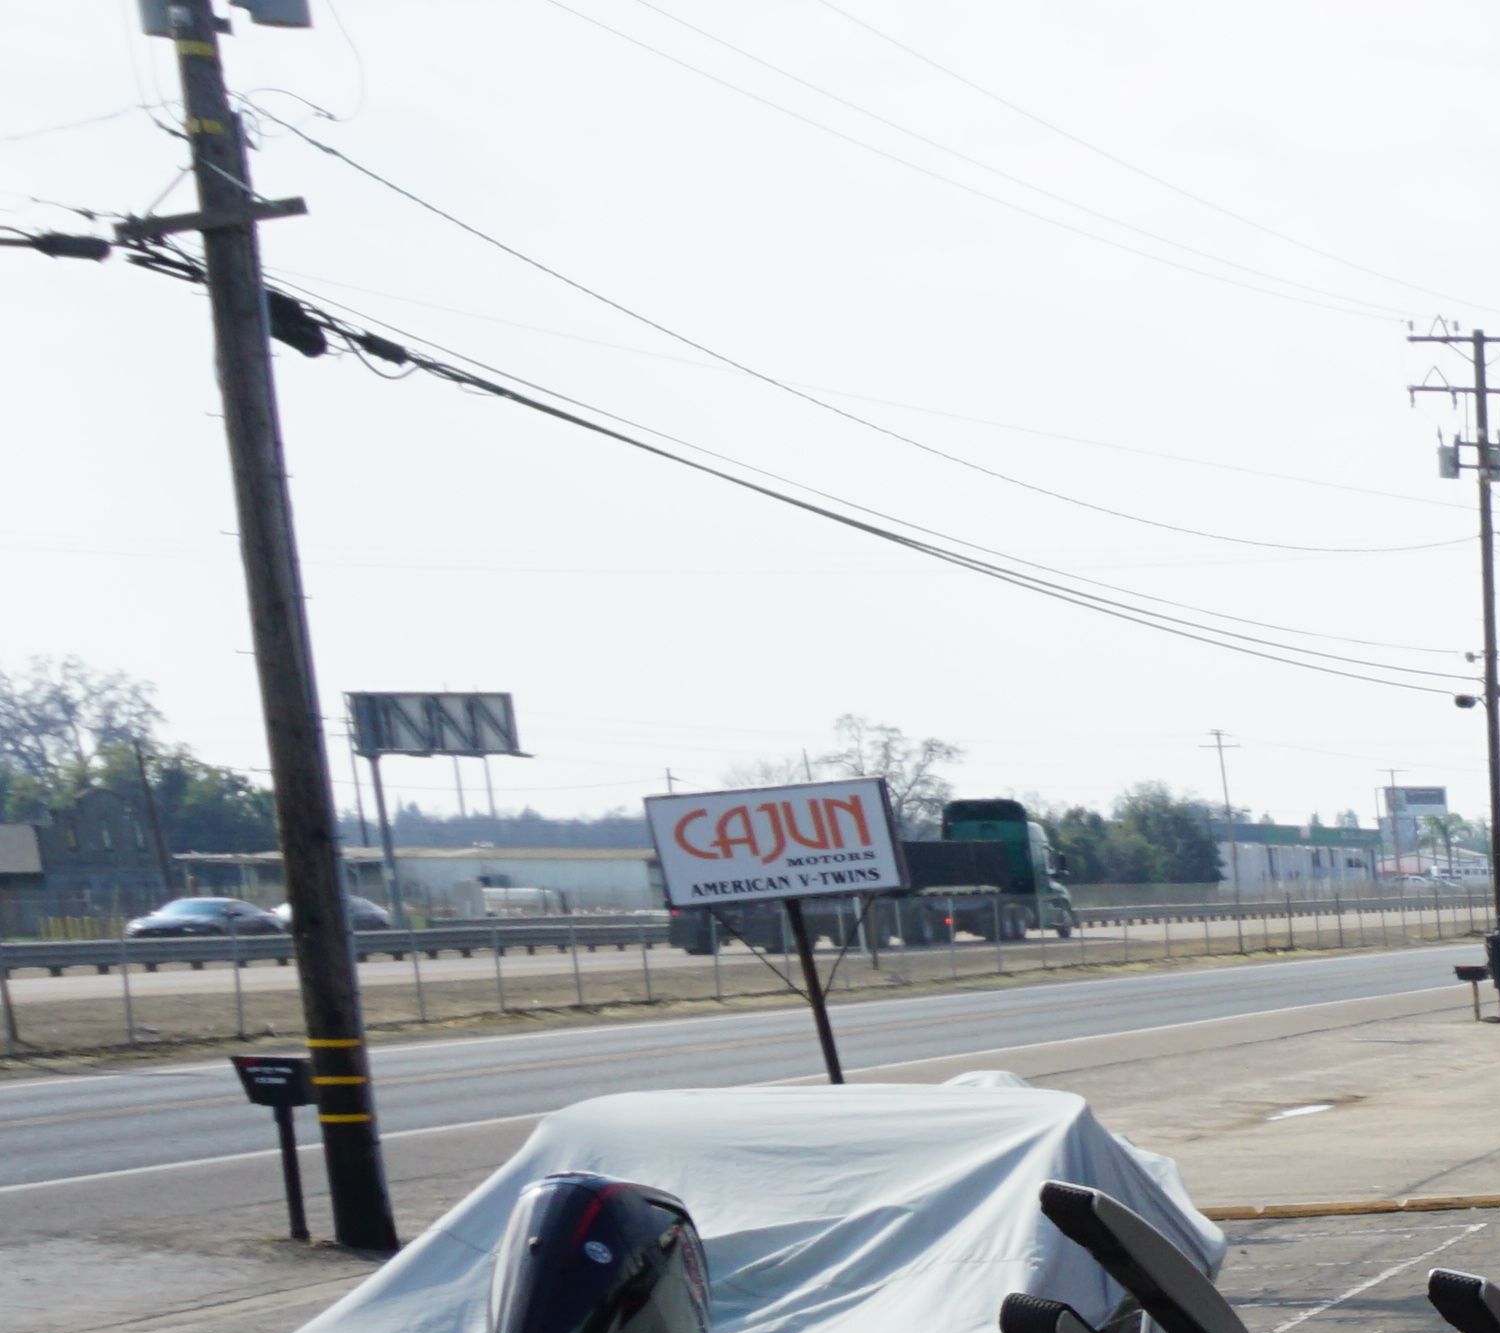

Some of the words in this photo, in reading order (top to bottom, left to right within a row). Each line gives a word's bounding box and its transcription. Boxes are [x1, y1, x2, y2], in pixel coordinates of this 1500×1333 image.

[673, 794, 872, 865] CAJUN
[786, 850, 876, 867] MOTORS
[691, 876, 791, 897] AMERICAN
[798, 867, 882, 887] V-TWINS
